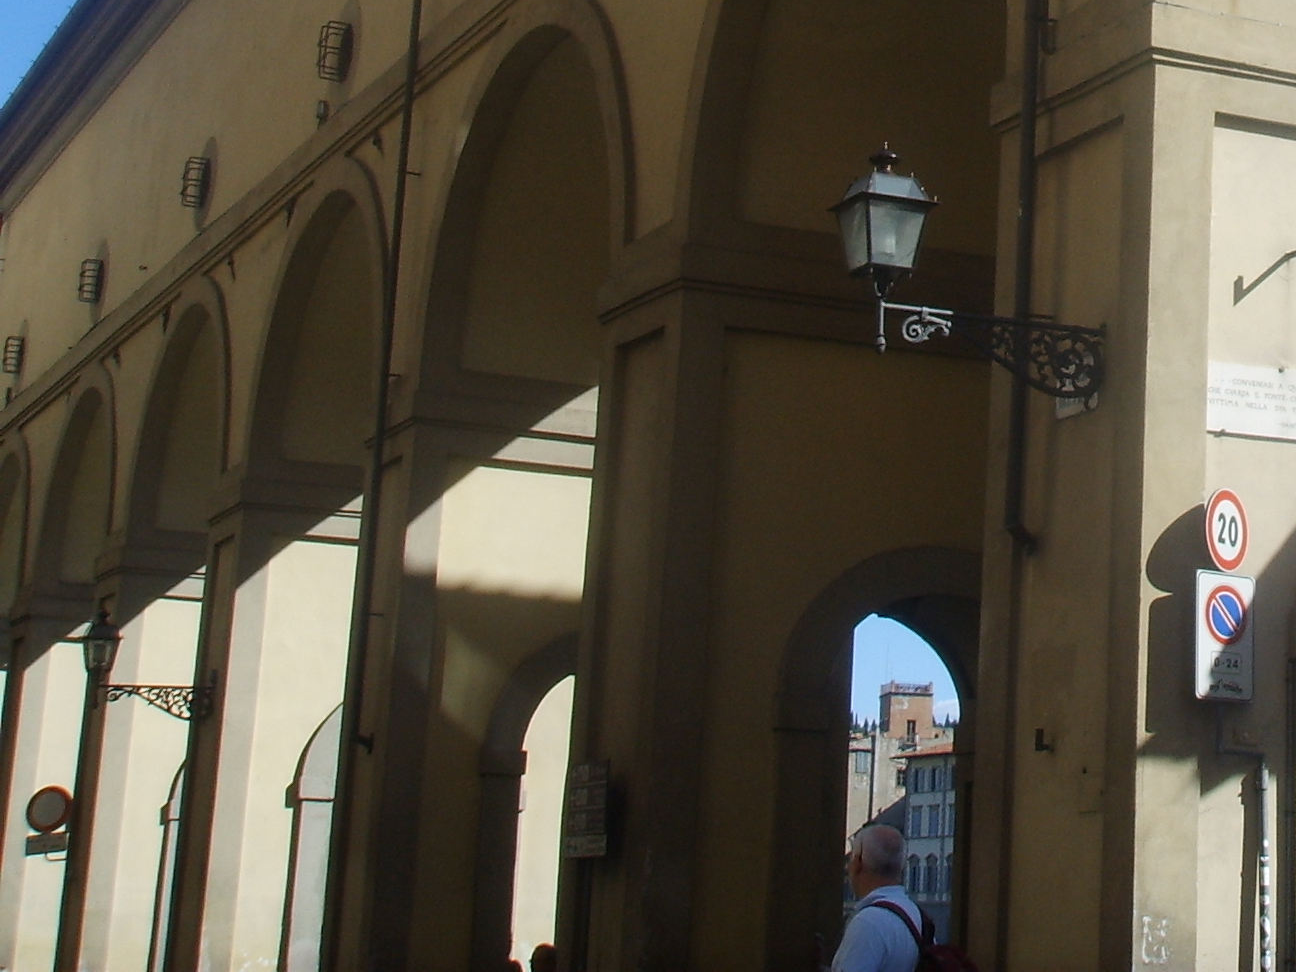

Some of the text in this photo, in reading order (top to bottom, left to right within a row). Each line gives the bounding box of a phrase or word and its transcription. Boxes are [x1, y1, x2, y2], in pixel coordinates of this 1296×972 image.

[1208, 386, 1222, 394] CHE
[1208, 398, 1239, 408] VITTIMA
[1245, 402, 1268, 410] NELLA
[1217, 512, 1239, 548] 20
